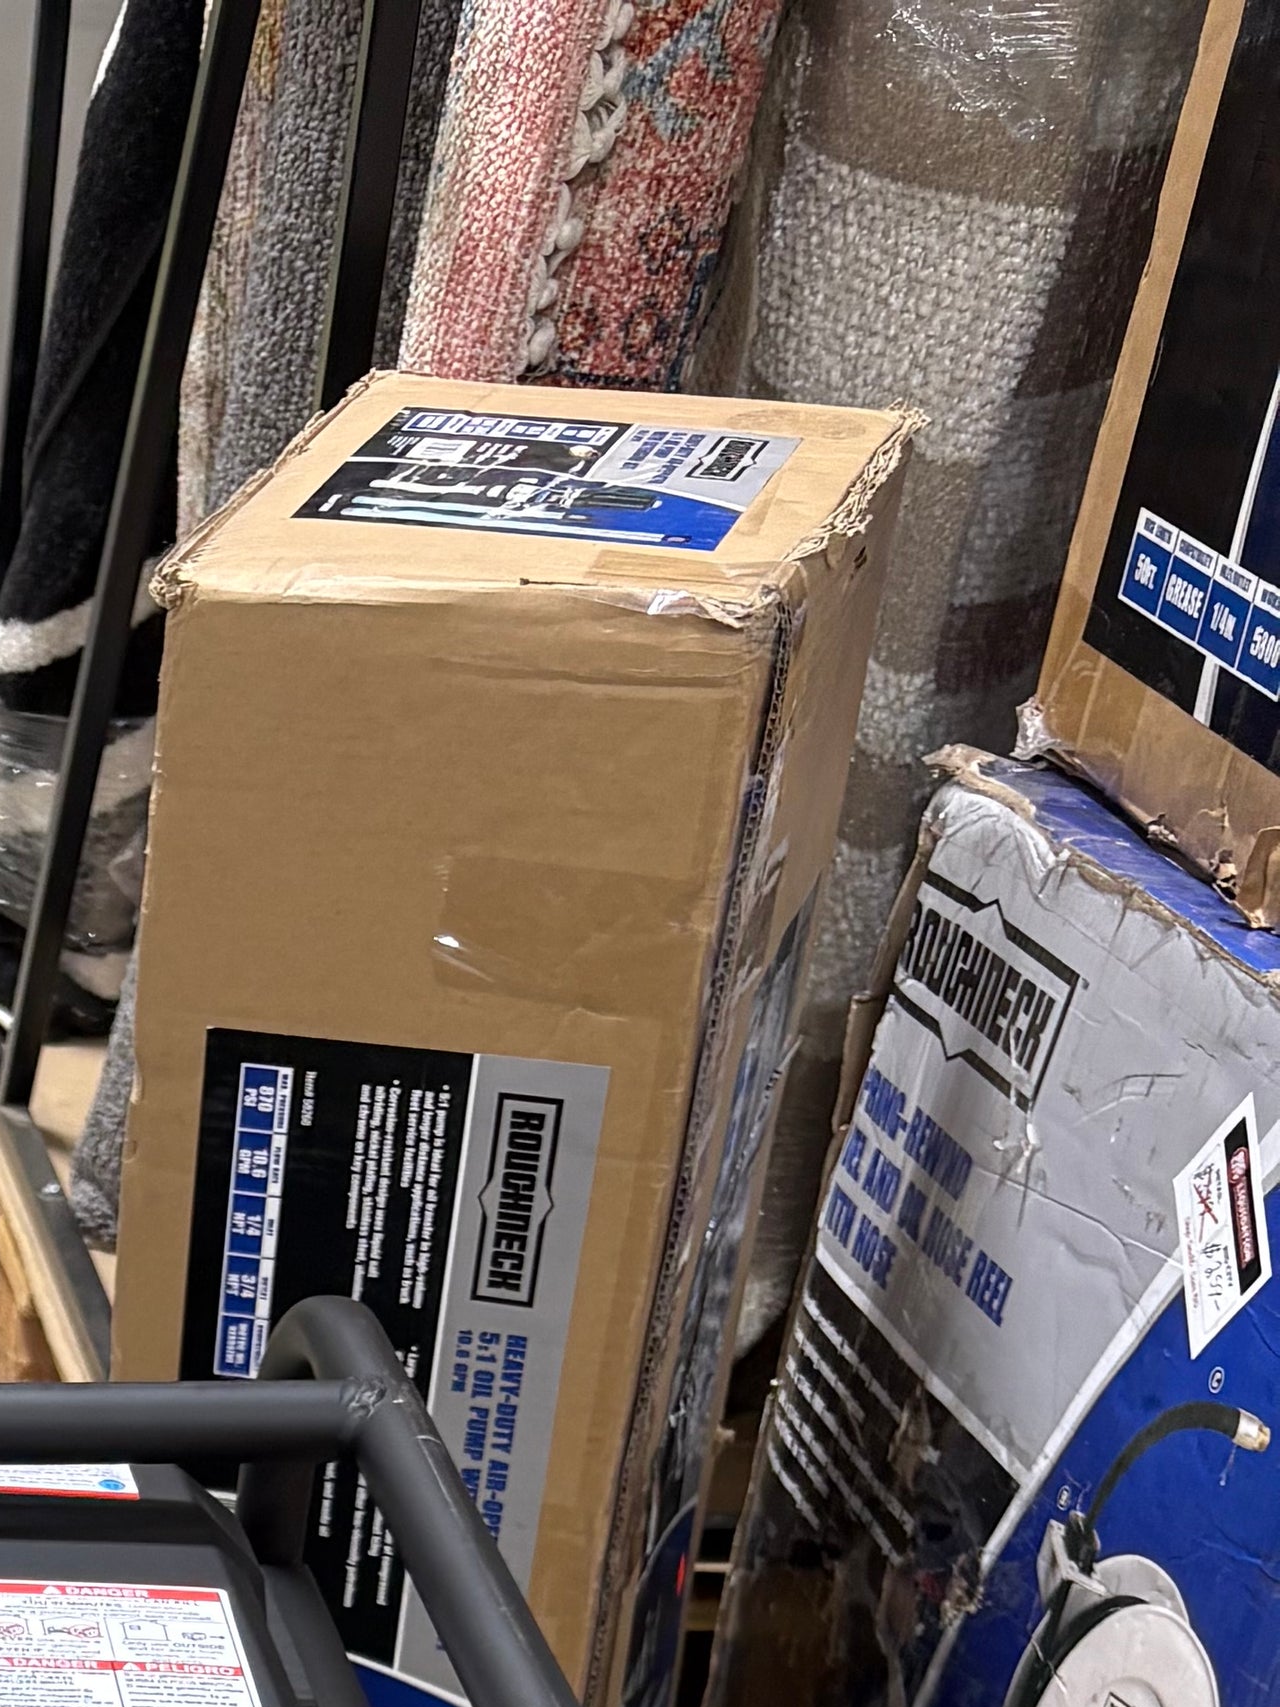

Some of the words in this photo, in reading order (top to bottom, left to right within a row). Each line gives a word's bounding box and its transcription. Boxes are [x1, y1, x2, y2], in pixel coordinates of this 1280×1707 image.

[1165, 573, 1205, 619] GREASE
[899, 900, 1058, 1070] ROUGHNECK
[243, 1087, 258, 1108] PSI
[256, 1085, 275, 1113] 870
[423, 1090, 435, 1110] and
[405, 1112, 419, 1146] service
[419, 1110, 434, 1141] longer
[433, 1109, 447, 1137] pump
[251, 1147, 269, 1179] 10.6
[414, 1141, 430, 1182] distance
[430, 1148, 445, 1173] ideal
[375, 1177, 391, 1208] design
[427, 1173, 441, 1188] for
[487, 1108, 547, 1293] ROUGHNECK
[421, 1202, 437, 1240] transfer
[851, 1214, 898, 1290] HOSE
[862, 1147, 902, 1214] AND
[965, 1249, 1013, 1328] REEL
[241, 1274, 257, 1299] 3/4
[475, 1330, 501, 1364] 5:1
[451, 1362, 469, 1392] GPM
[470, 1369, 495, 1399] OIL
[491, 1333, 528, 1455] HEAVY-DUTY
[463, 1405, 490, 1462] PUMP
[65, 1586, 149, 1598] DANGER
[13, 1658, 98, 1668] DANGER
[145, 1663, 235, 1675] PELIGRO
